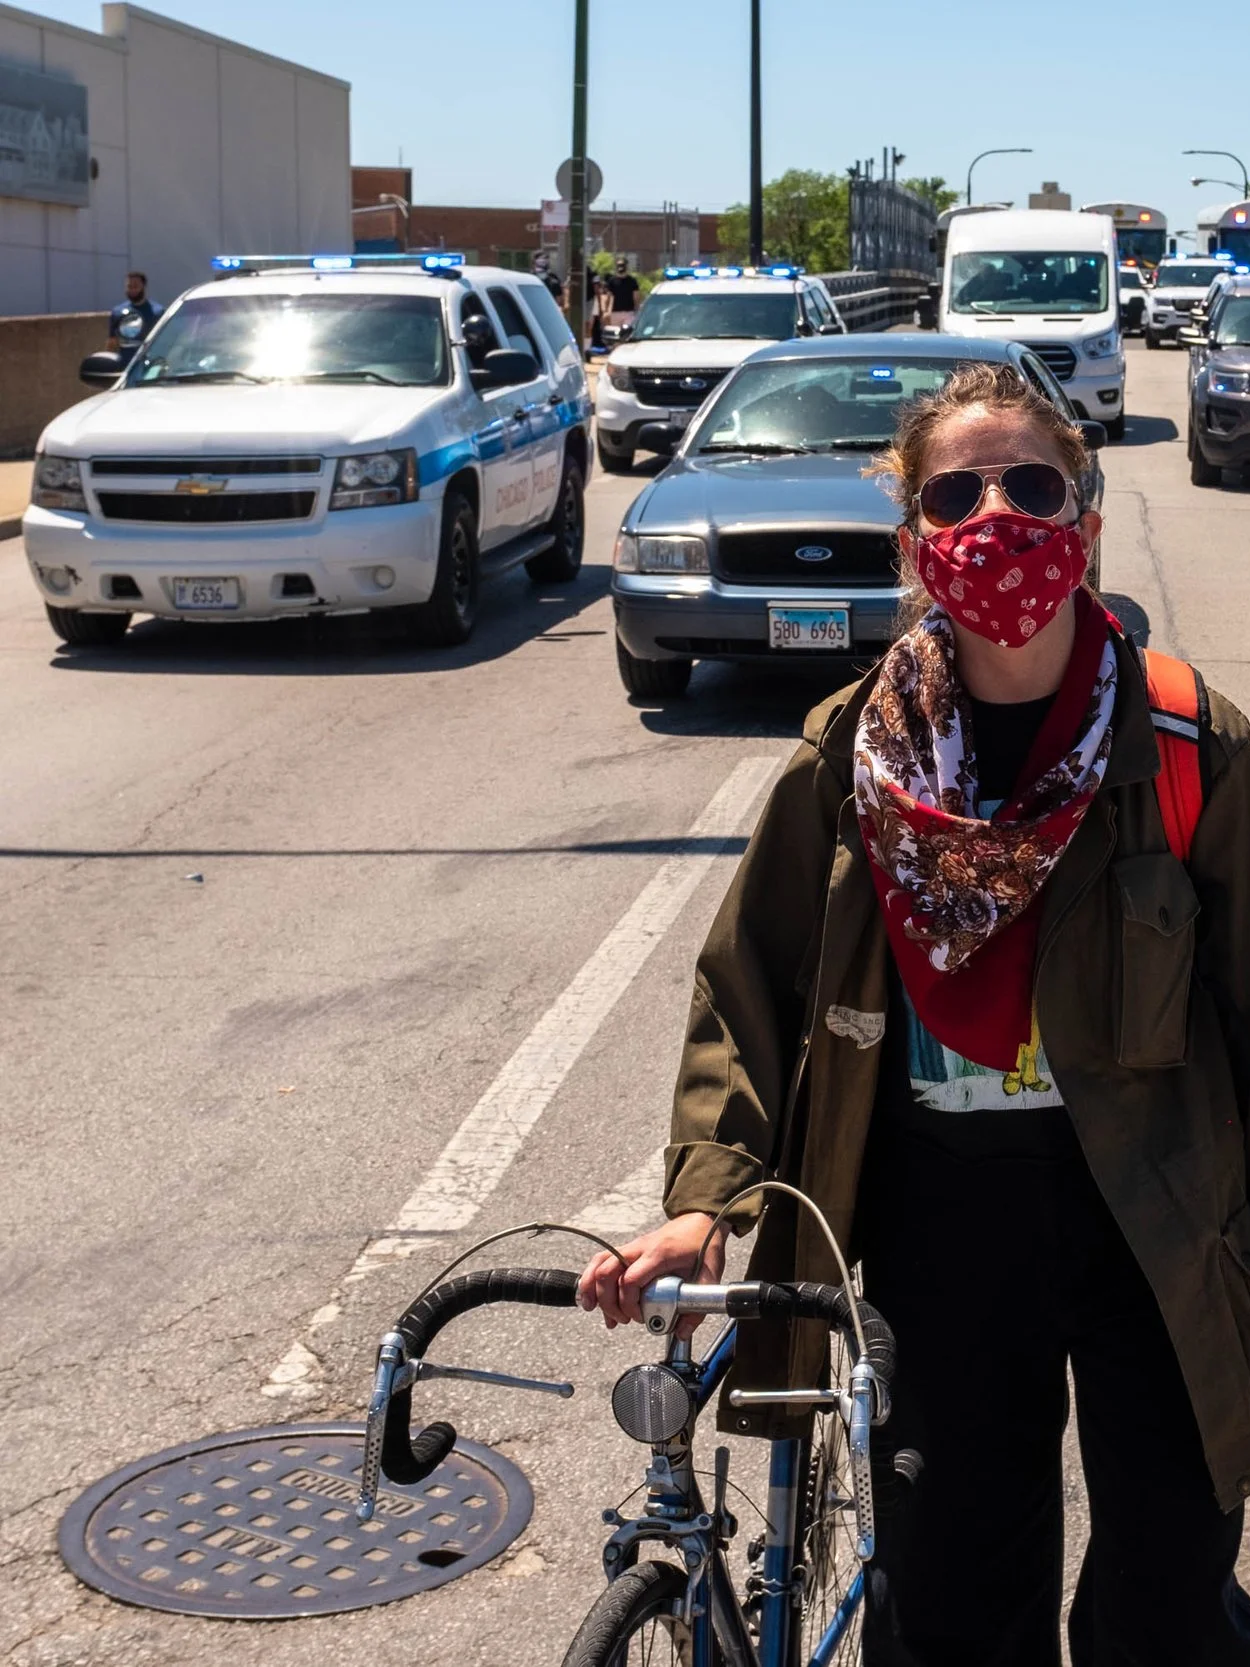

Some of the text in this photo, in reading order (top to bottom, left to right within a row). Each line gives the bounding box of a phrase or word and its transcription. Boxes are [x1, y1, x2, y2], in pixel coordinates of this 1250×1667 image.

[191, 586, 223, 604] 6536
[773, 620, 845, 641] 580 6965
[291, 1473, 414, 1517] CHICGO
